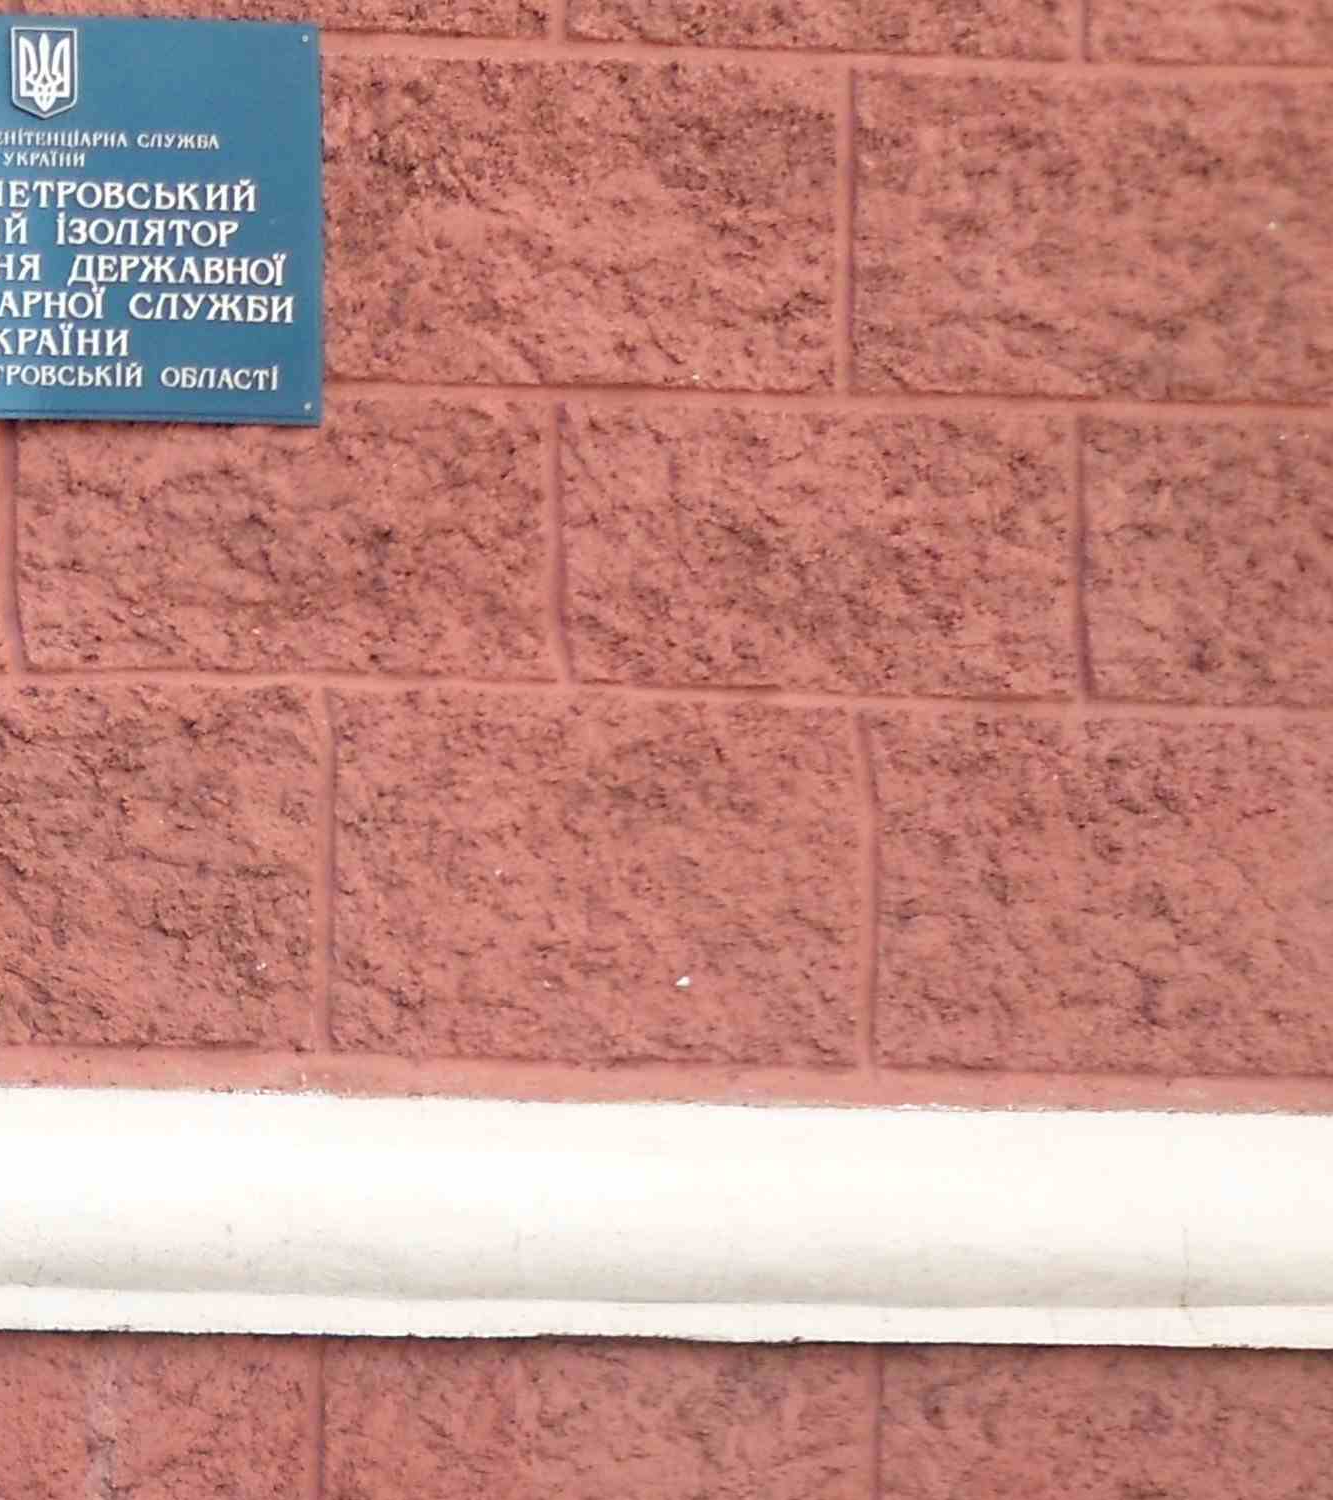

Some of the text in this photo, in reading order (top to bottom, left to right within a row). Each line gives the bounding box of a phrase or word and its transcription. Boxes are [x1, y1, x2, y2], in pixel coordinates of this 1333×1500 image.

[136, 133, 220, 150] СЛУЖБА
[2, 150, 86, 168] УКРАЇНИ
[56, 217, 239, 248] ІЗОЛЯТОР
[67, 253, 288, 287] ДЕРЖАВНОЇ
[128, 291, 294, 324] СЛУЖБИ
[161, 366, 279, 391] ОБЛАСТІ
